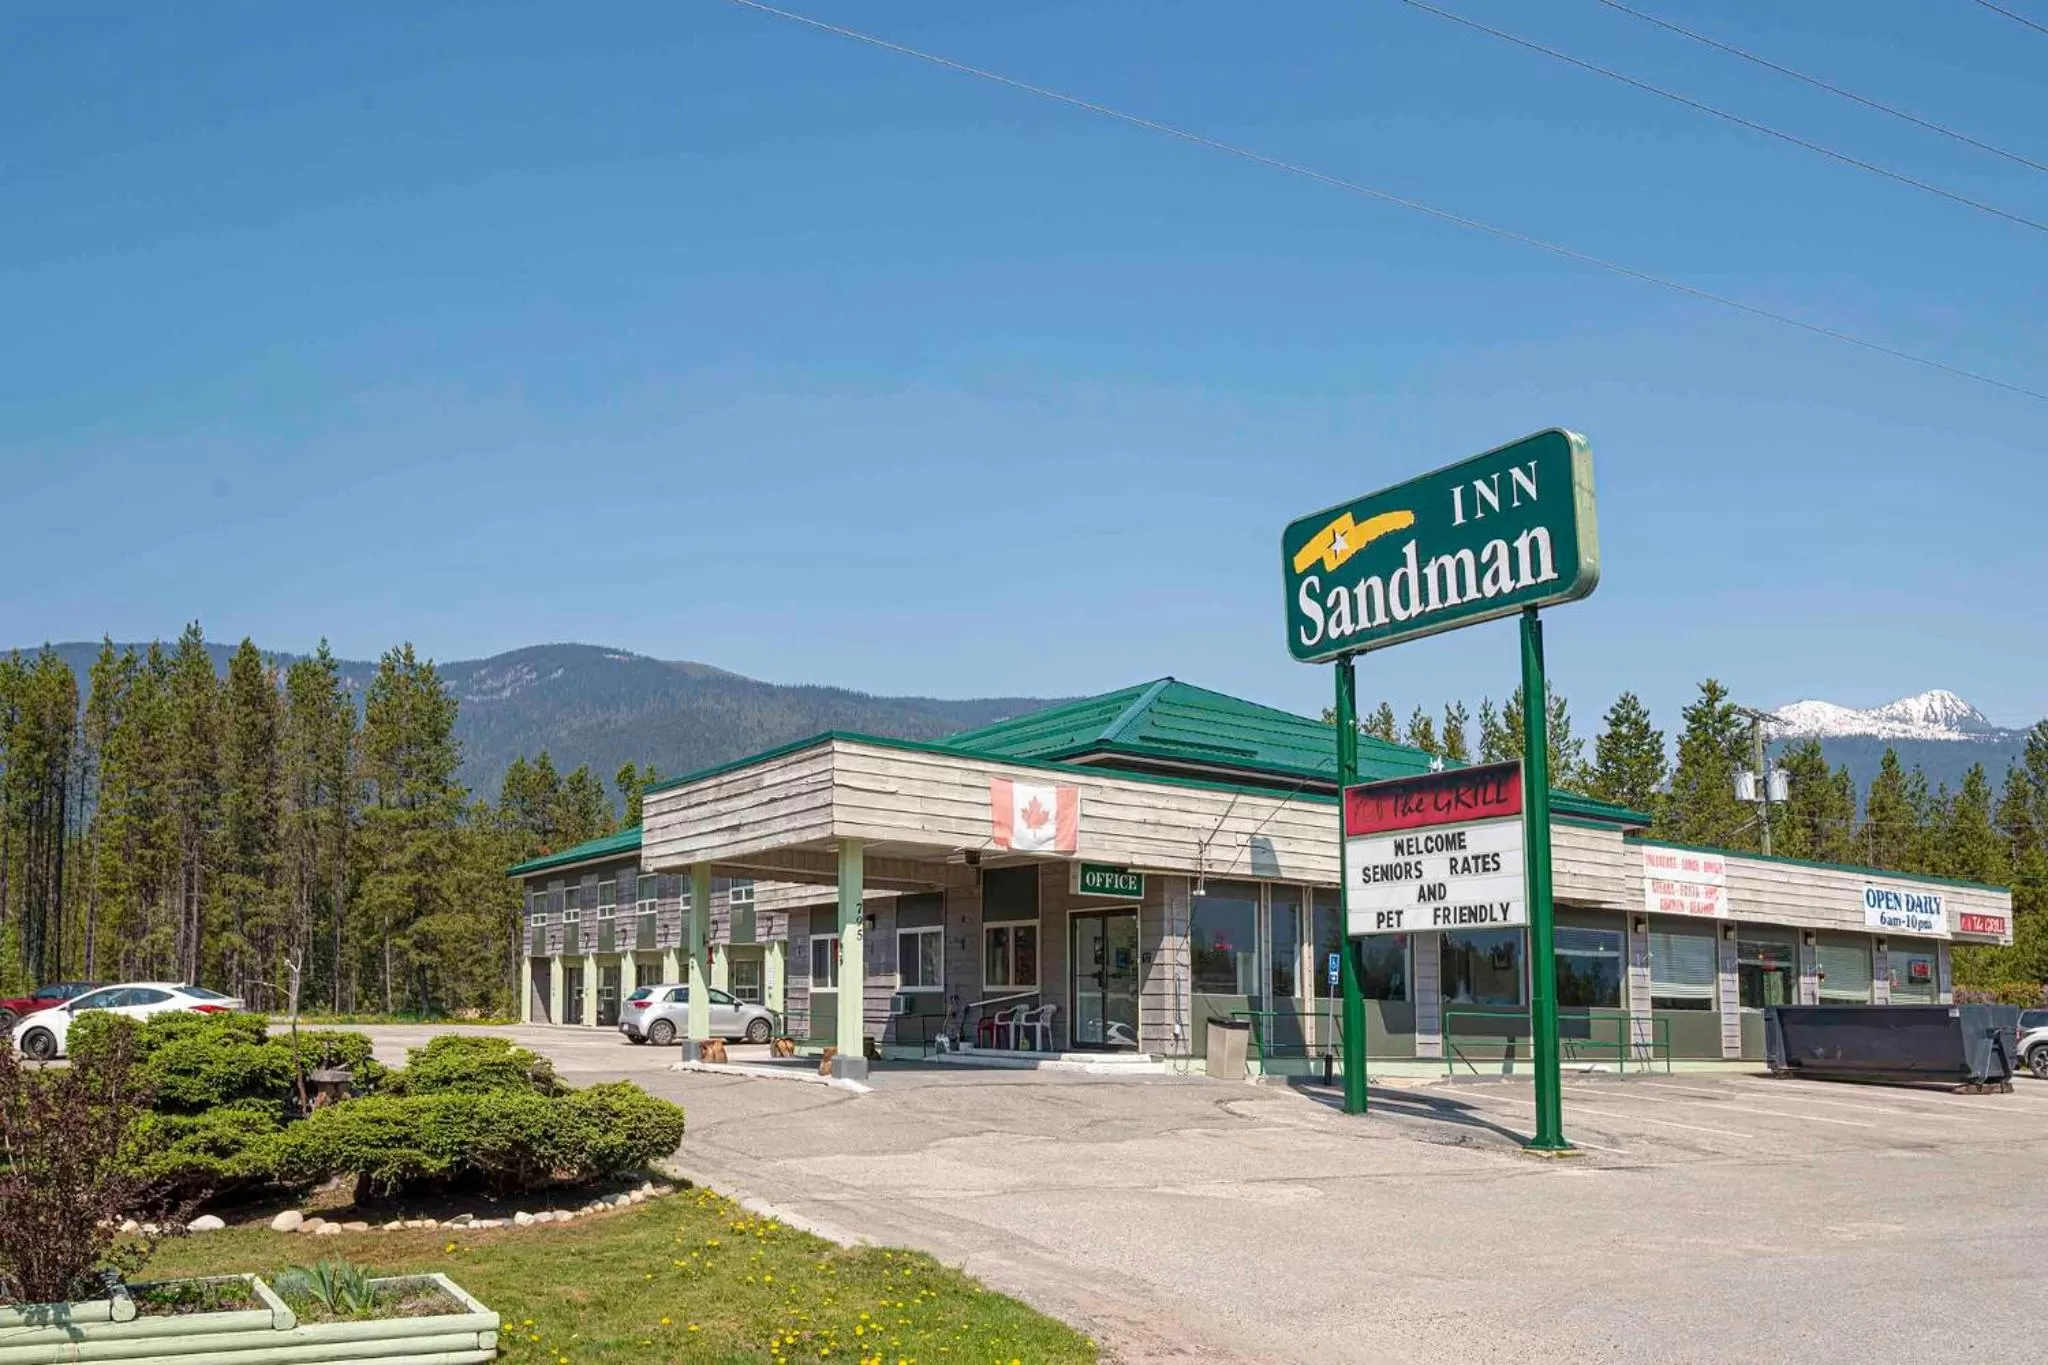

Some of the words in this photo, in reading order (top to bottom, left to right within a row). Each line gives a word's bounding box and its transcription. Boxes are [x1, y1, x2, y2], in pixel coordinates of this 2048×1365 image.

[1450, 460, 1538, 526] INN
[1298, 525, 1559, 646] Sandman
[1394, 832, 1467, 857] WELCOME
[1086, 872, 1137, 890] OFFICE
[1362, 861, 1423, 884] SENIORS
[1450, 853, 1501, 875] RATES
[1417, 883, 1447, 902] AND
[1866, 888, 1902, 911] OPEN
[1905, 893, 1941, 915] DAILY
[1377, 910, 1403, 929] PET
[1433, 903, 1510, 926] FRIENDLY
